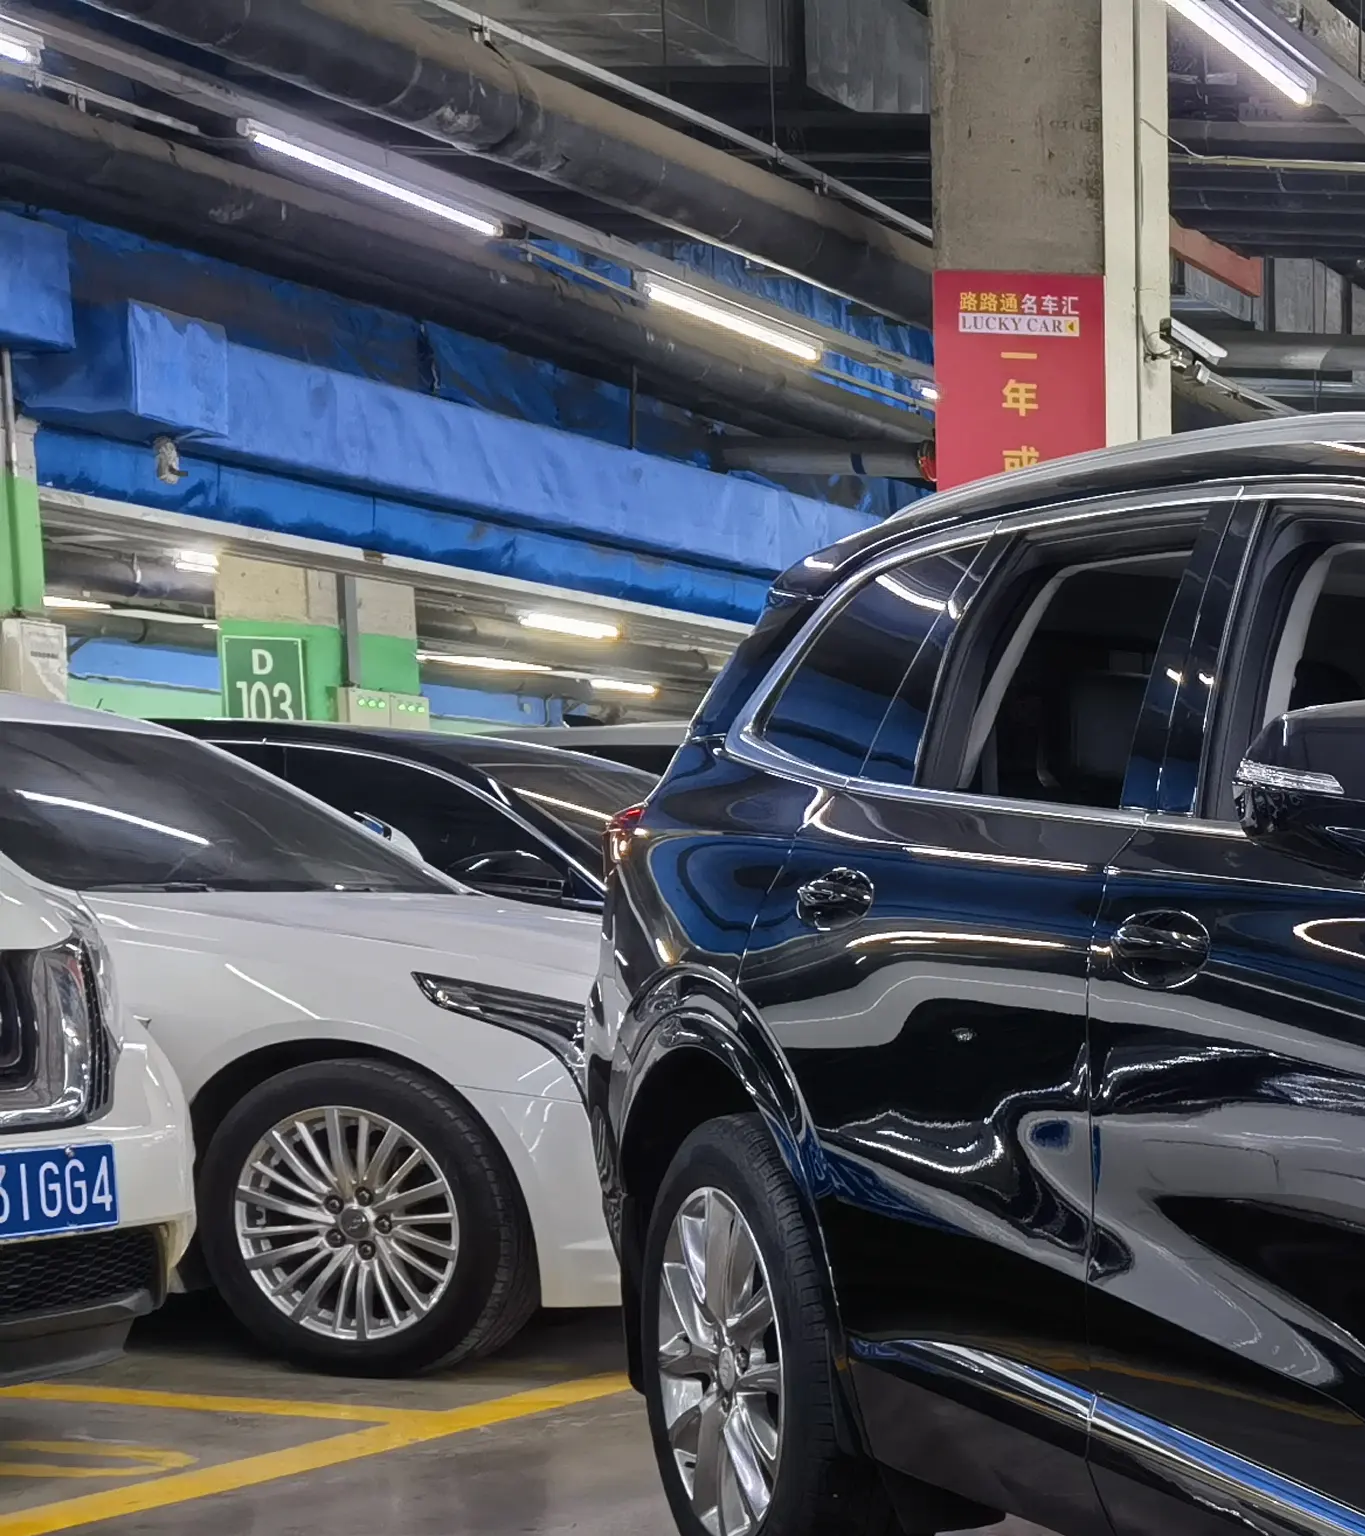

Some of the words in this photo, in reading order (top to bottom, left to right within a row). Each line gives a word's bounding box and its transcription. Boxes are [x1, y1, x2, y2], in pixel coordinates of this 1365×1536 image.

[959, 291, 1080, 315] 路路通名车汇
[961, 315, 1022, 331] LUCKY
[1027, 318, 1063, 333] CAR
[251, 648, 273, 675] D
[236, 681, 294, 720] 103
